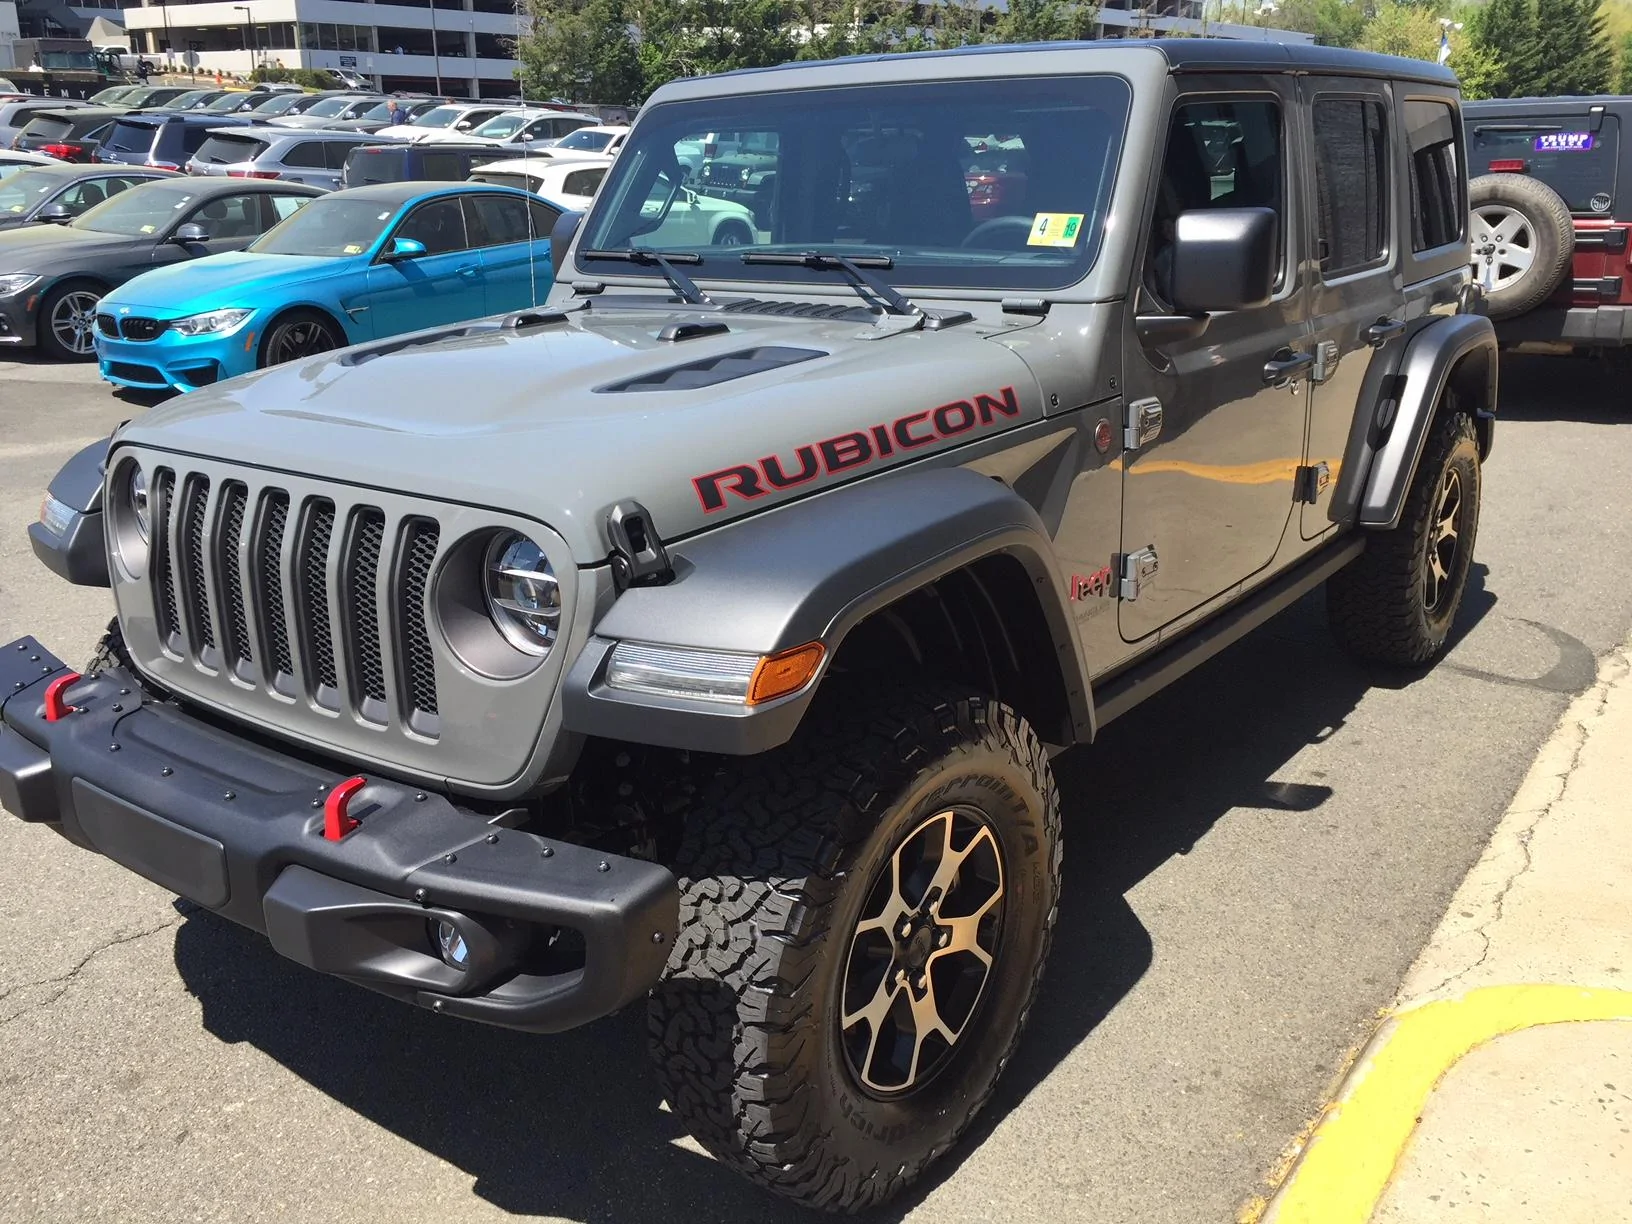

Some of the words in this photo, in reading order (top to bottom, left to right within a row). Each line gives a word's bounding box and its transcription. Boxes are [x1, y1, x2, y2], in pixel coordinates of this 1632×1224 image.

[1540, 134, 1589, 143] TRUMP
[1039, 217, 1048, 235] 4
[1064, 221, 1077, 237] 19
[691, 385, 1020, 514] RUBICON
[1071, 567, 1113, 601] Jeep
